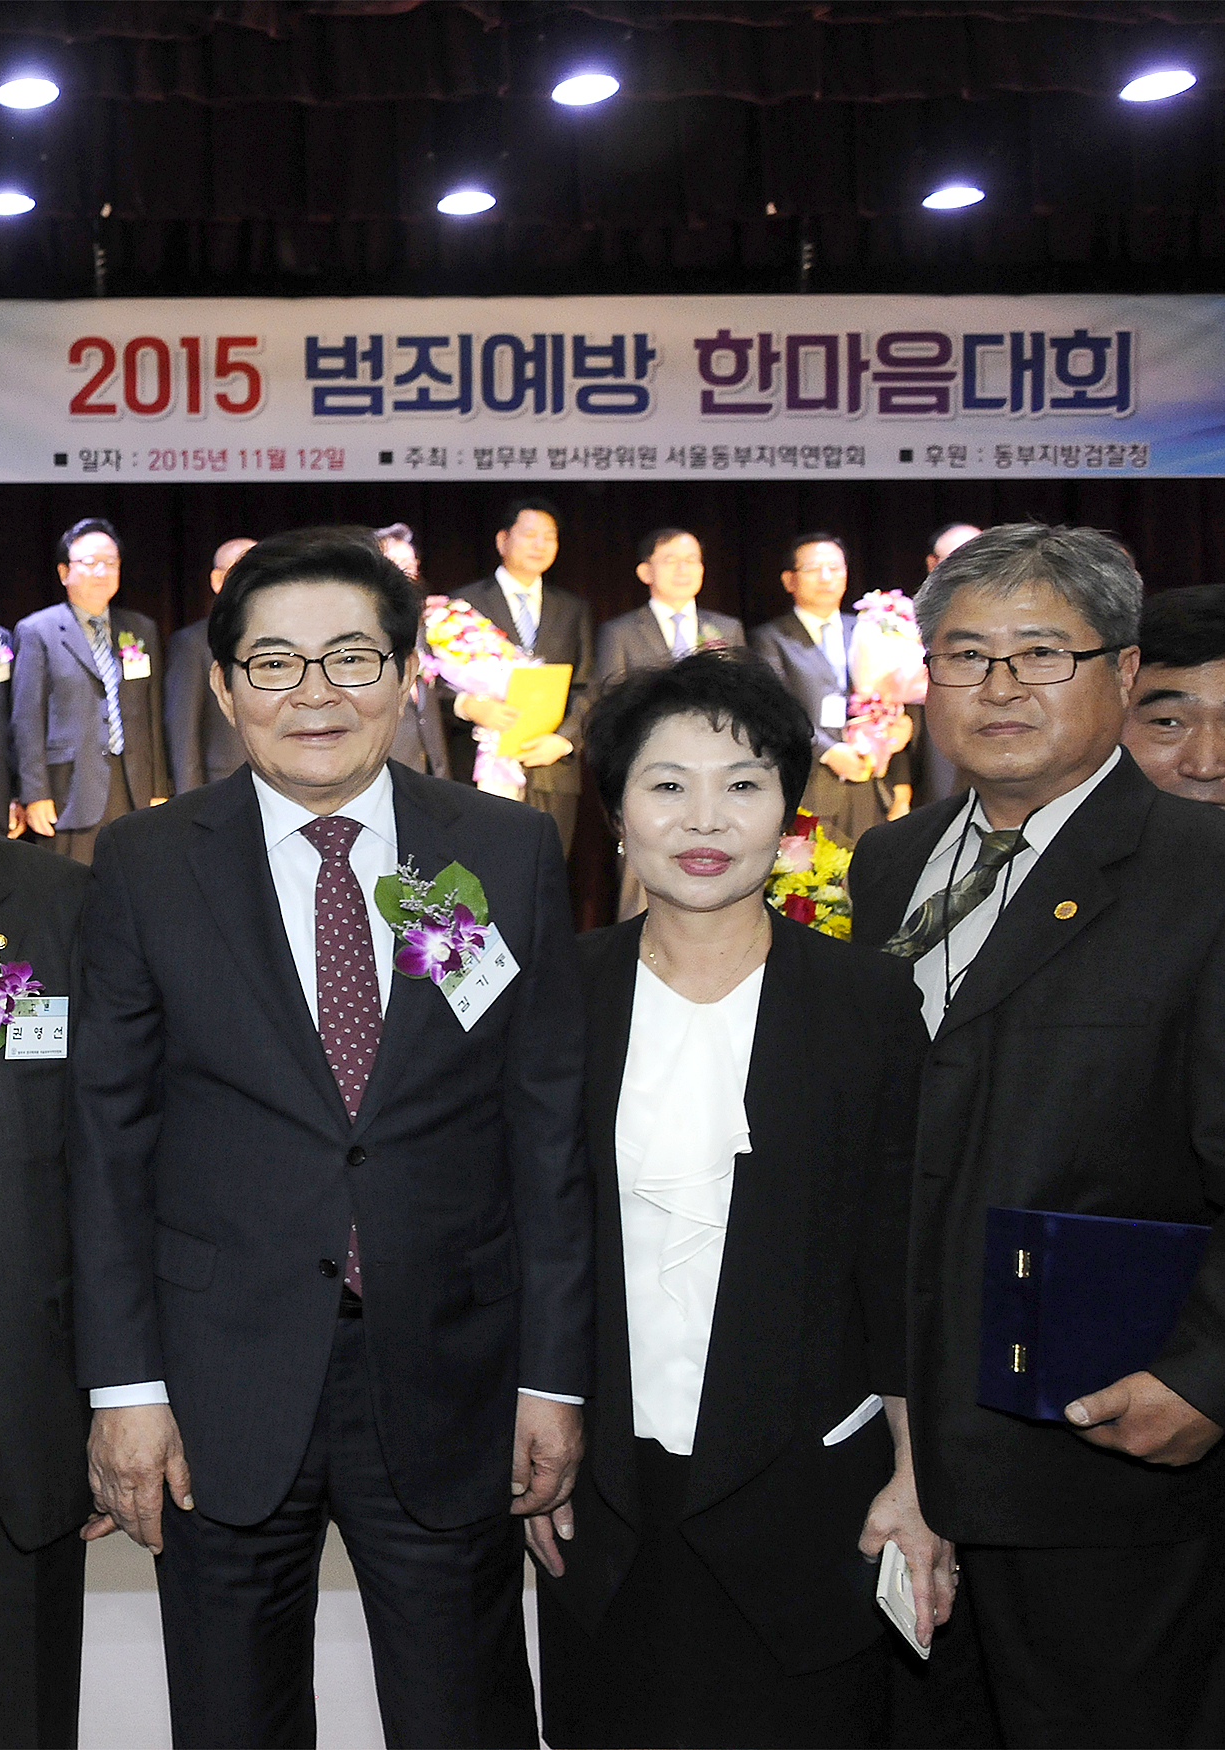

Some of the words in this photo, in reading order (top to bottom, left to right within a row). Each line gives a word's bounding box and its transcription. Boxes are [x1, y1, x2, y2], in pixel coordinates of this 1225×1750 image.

[68, 336, 262, 415] 2015
[305, 333, 657, 416] 범죄예방
[78, 448, 122, 473] 일자
[148, 448, 228, 472] 2015년
[239, 448, 286, 471] 11월
[297, 447, 345, 471] 12일
[405, 446, 447, 469] 주최
[473, 446, 537, 471] 법무부
[547, 445, 657, 471] 법사랑위원
[666, 444, 866, 471] 서울동부지역연합회
[926, 444, 967, 469] 후원
[994, 444, 1149, 469] 동부지방검찰청
